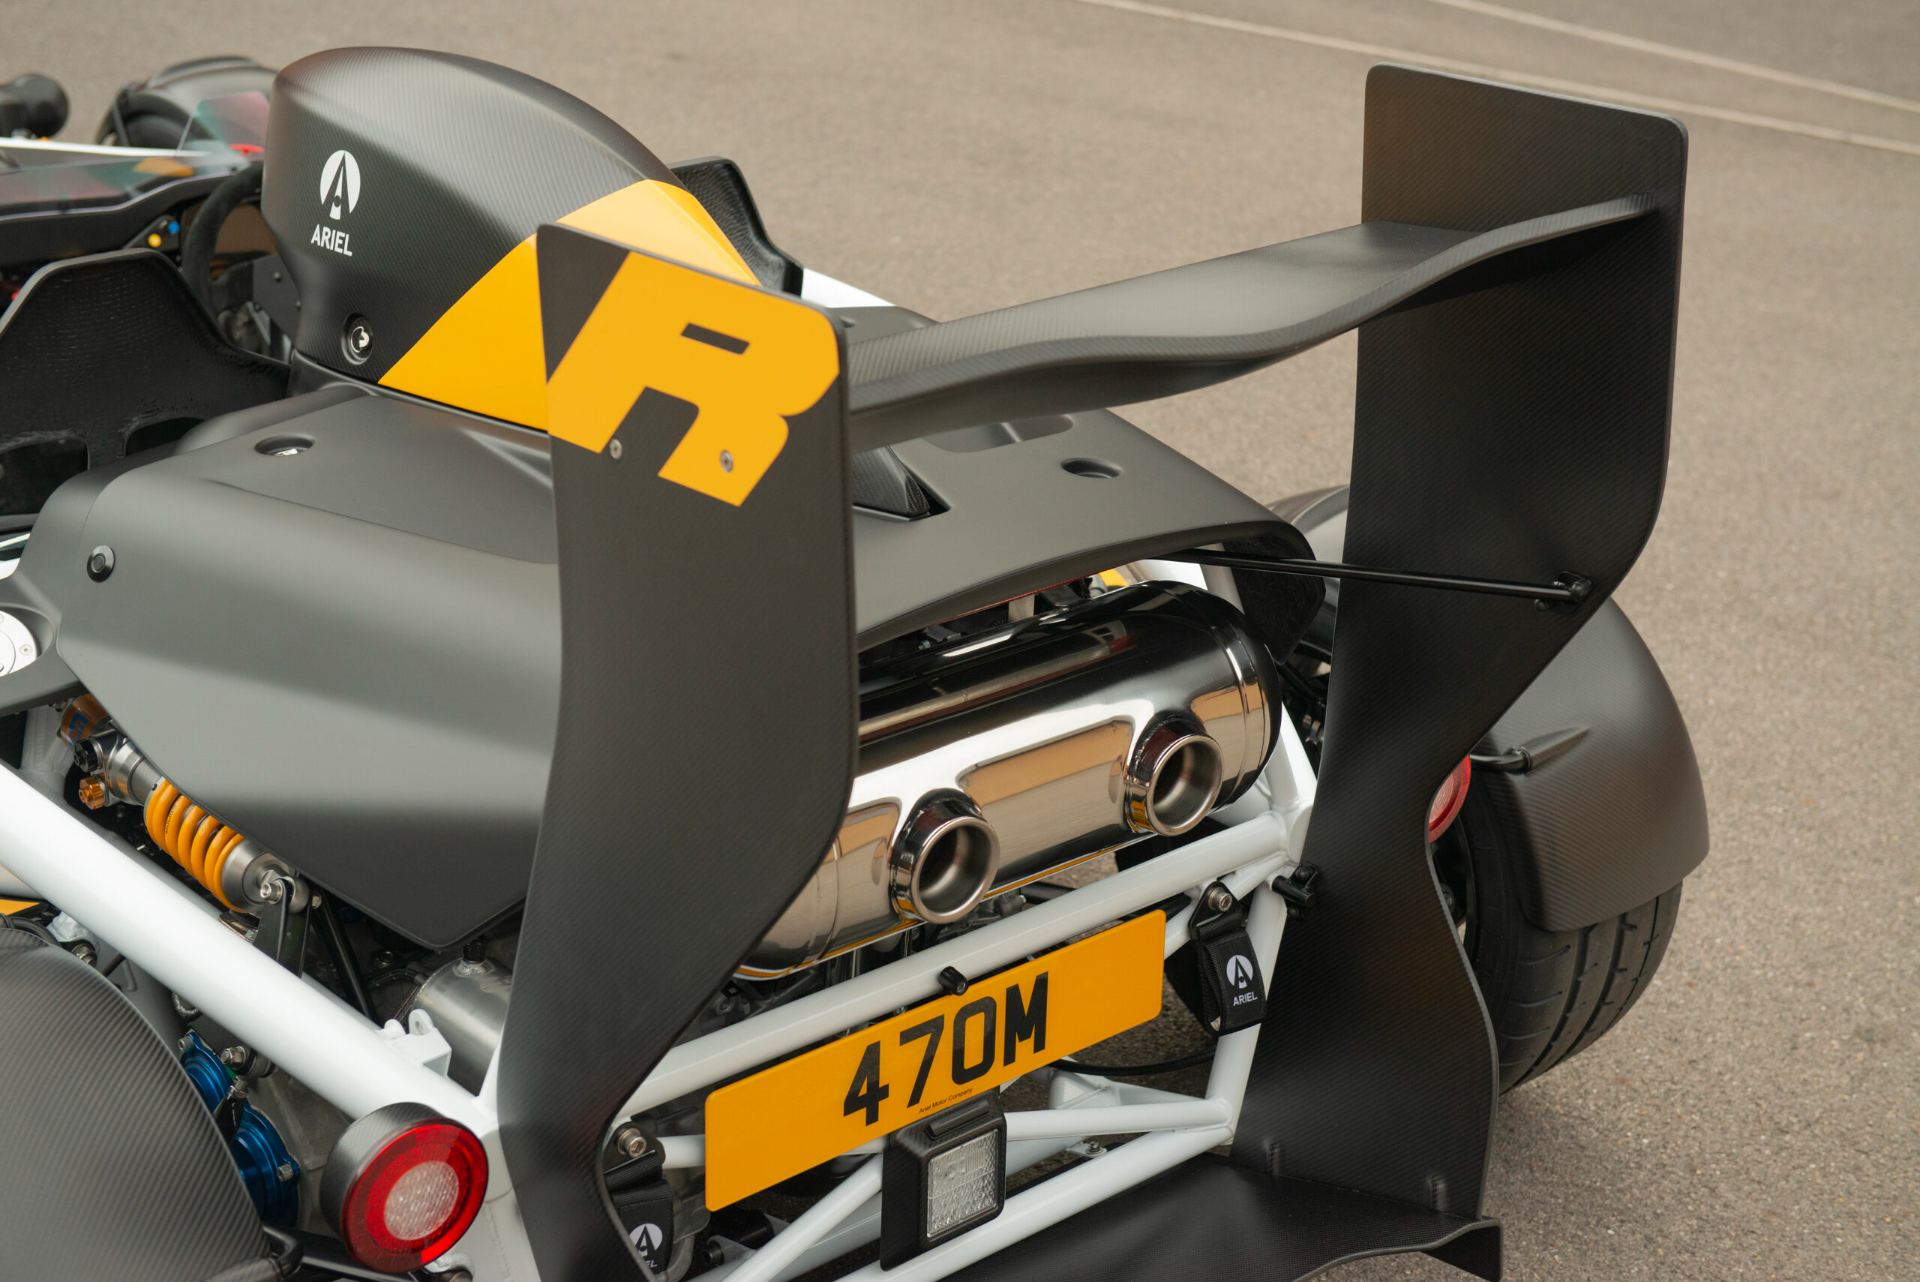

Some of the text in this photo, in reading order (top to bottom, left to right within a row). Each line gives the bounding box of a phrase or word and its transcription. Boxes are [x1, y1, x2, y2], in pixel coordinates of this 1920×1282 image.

[310, 223, 353, 257] ARIEL
[545, 250, 840, 508] R
[1232, 991, 1259, 1007] ARIEL
[843, 970, 1049, 1127] 470M
[948, 1088, 973, 1101] Company
